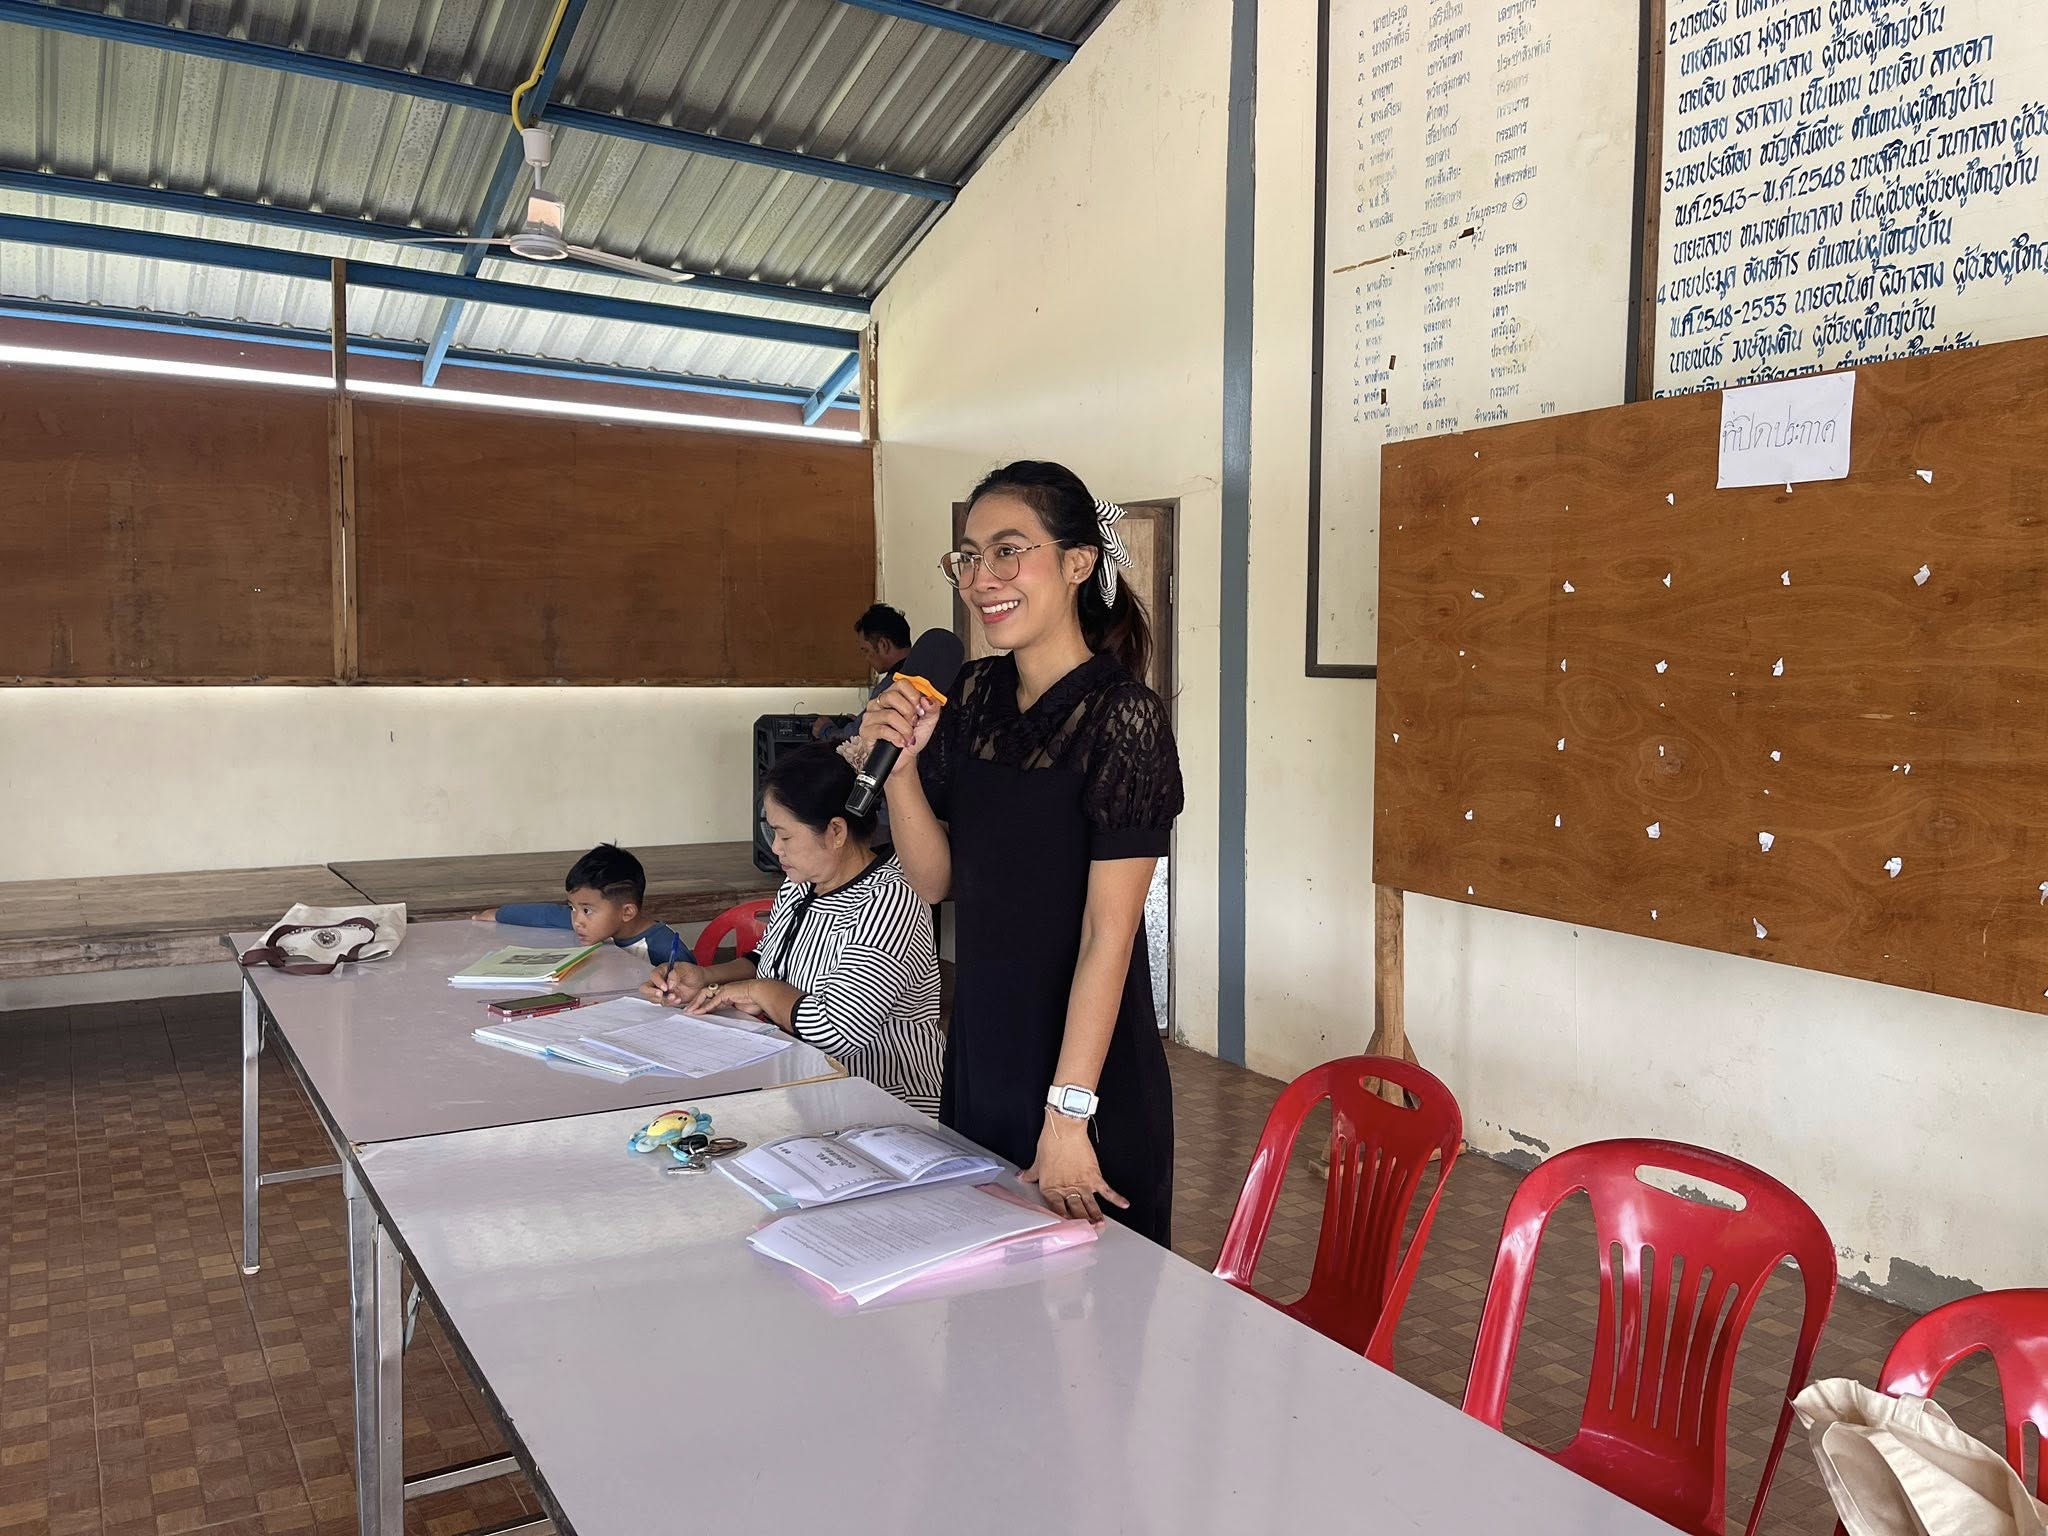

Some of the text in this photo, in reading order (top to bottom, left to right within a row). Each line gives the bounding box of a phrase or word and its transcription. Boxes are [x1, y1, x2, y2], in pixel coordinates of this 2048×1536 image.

[1676, 75, 1726, 115] นายเอิบ
[1822, 0, 1945, 78] ผู้ช่วยผู้ใหญ่บ้าน
[1800, 75, 1862, 116] เป็นแทน
[1868, 52, 1925, 96] นายเอิบ
[1930, 34, 1993, 78] ลาออก
[1852, 73, 1994, 140] ตำแหน่งผู้ใหญ่บ้าน
[1496, 120, 1528, 143] กรรมการ
[1494, 144, 1527, 166] กรรมการ
[1494, 242, 1518, 257] ประธาน
[1671, 266, 1737, 301] นายประมูล
[1808, 211, 1952, 273] ตำแหน่งผู้ใหญ่บ้าน
[1493, 260, 1528, 277] รองประธาน
[1493, 280, 1527, 297] รองประธาน
[1670, 331, 1732, 373] นายพันธ์
[1813, 298, 1936, 357] ผู้ช่วยผู้ใหญ่บ้าน
[1489, 383, 1521, 399] กรรมการ
[1474, 403, 1509, 423] จำนวนเงิน
[1540, 401, 1556, 414] บาท
